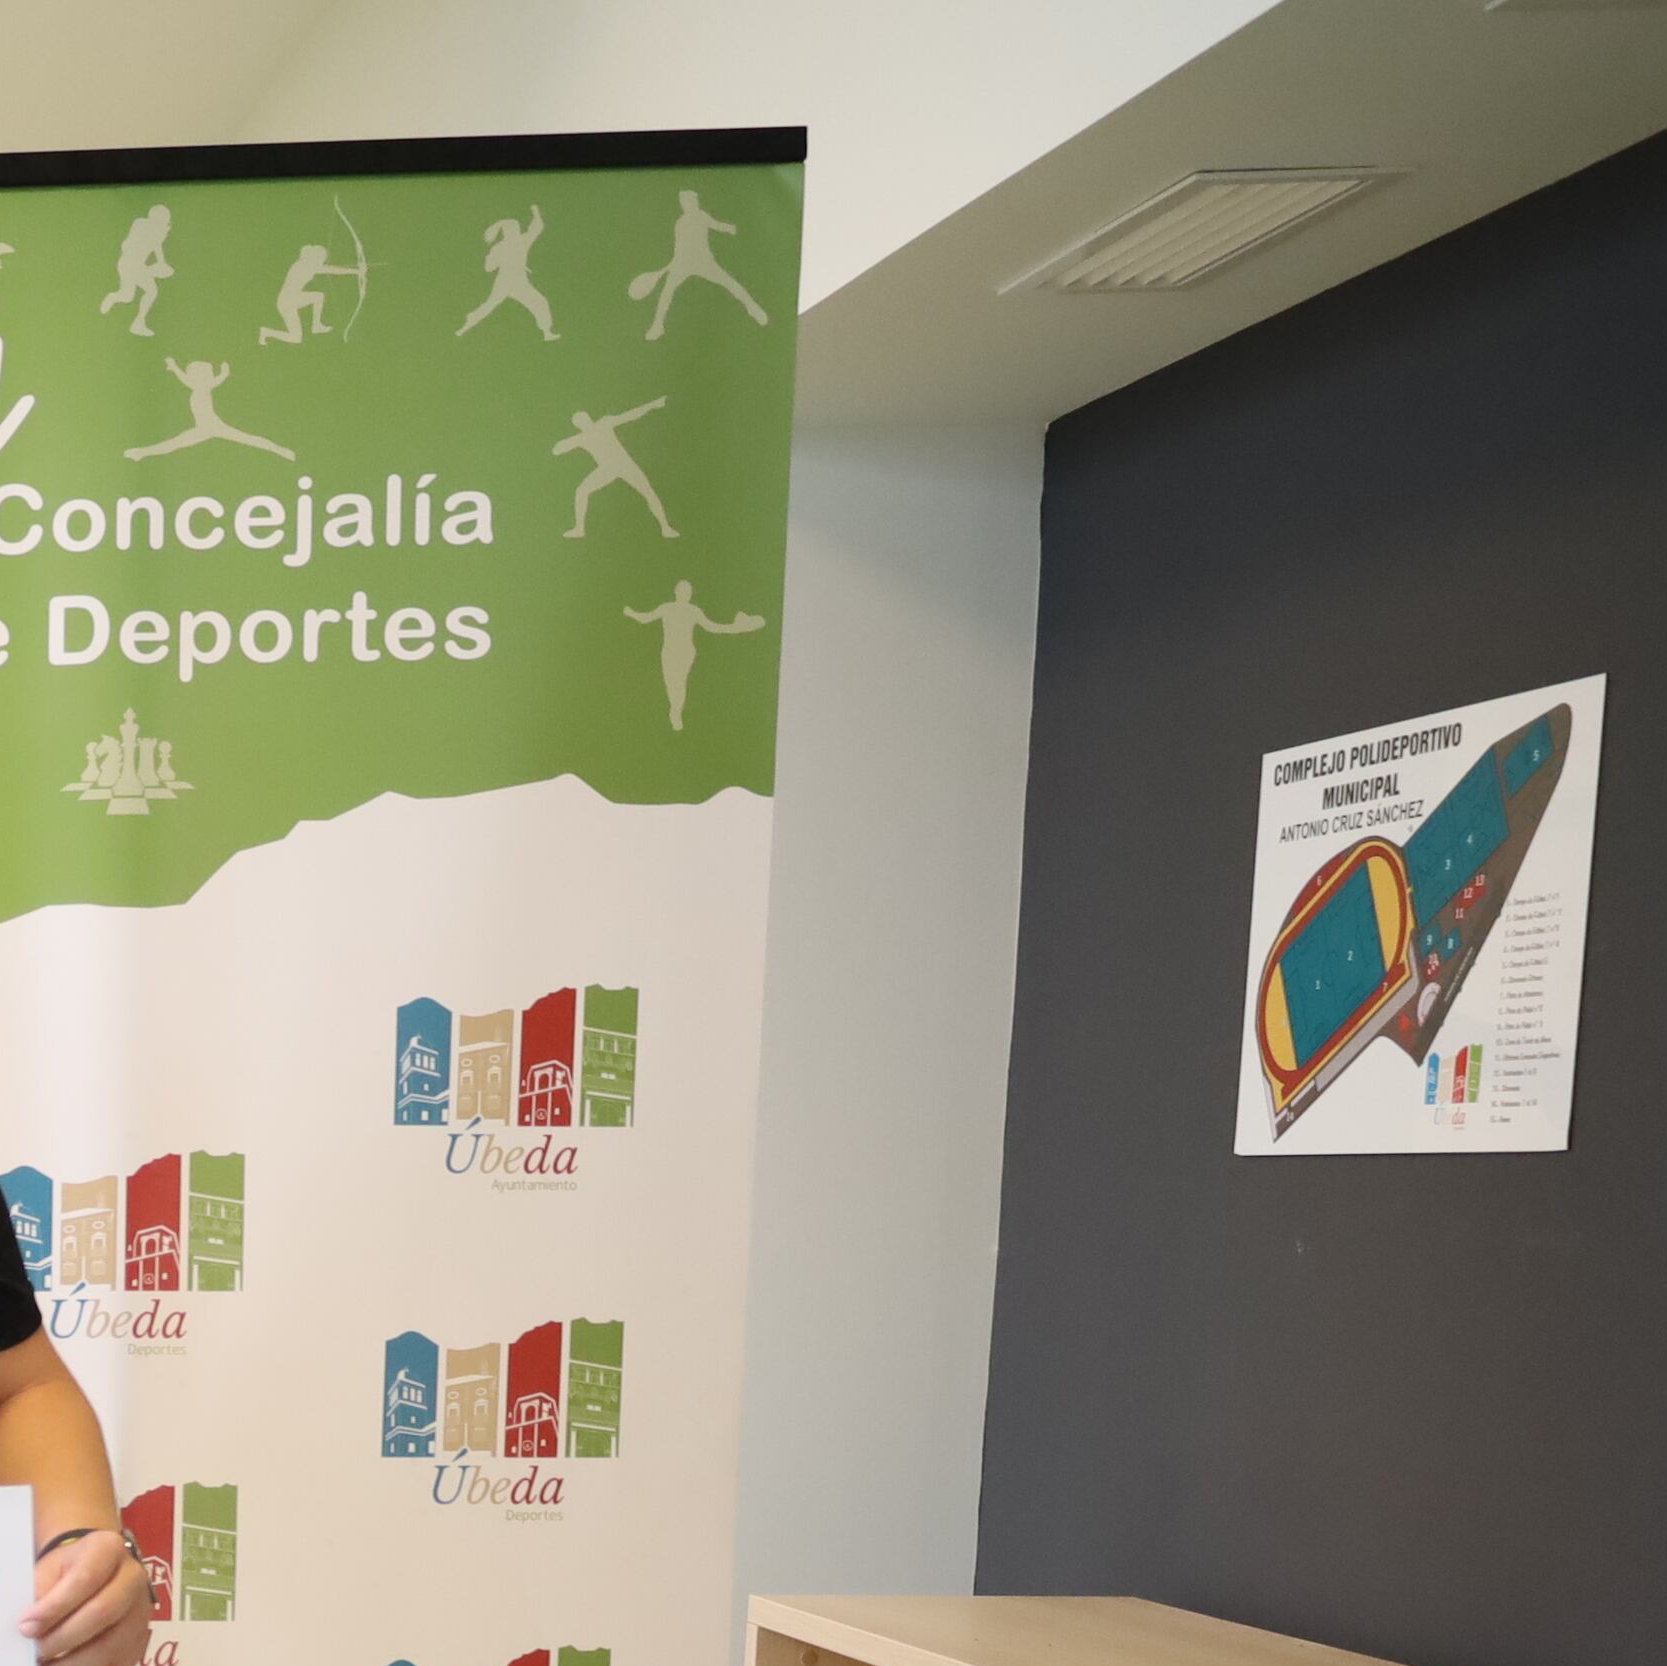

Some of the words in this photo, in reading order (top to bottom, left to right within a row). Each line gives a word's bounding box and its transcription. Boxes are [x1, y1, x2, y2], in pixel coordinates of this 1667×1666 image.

[47, 590, 492, 683] Deportes
[1274, 750, 1345, 786] COMPLEJO
[1350, 722, 1462, 769] POLIDEPORTIVO
[1322, 773, 1400, 810] MUNICIPAL
[1280, 818, 1329, 843] ANTONIO
[1332, 812, 1363, 834] CRUZ
[1367, 800, 1424, 827] SÁNCHEZ
[445, 1116, 578, 1175] Úbeda
[491, 1178, 577, 1193] Ayuntamiento
[49, 1281, 187, 1340] Úbeda
[127, 1342, 187, 1358] Deportes
[432, 1448, 565, 1505] Úbeda
[506, 1509, 564, 1523] Deportes
